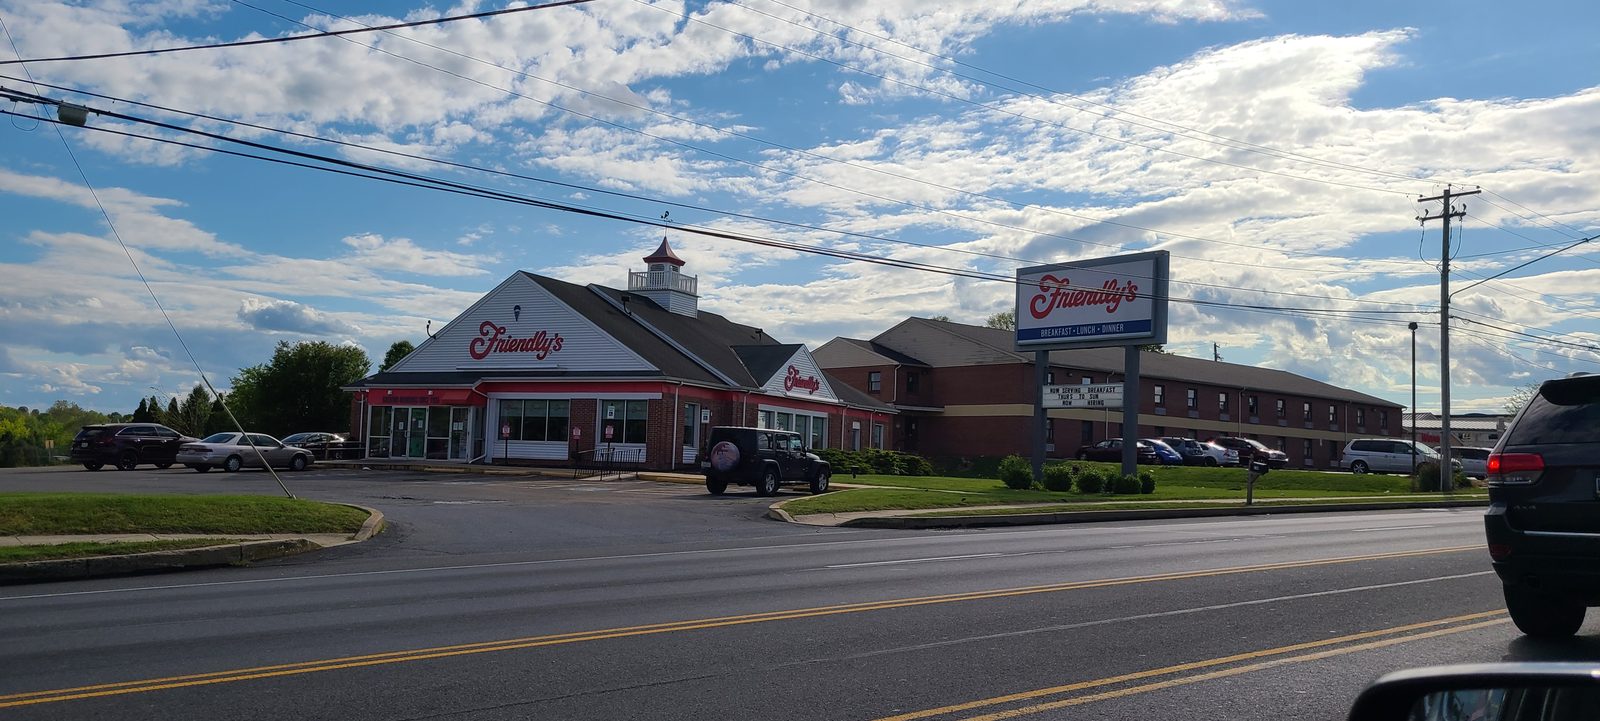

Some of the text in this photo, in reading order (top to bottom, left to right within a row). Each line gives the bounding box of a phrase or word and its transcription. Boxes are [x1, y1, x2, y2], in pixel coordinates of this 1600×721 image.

[1030, 274, 1138, 319] Friendly's
[469, 320, 564, 360] Friendly's
[1040, 323, 1124, 338] BREAKFAST LUNCH DINNER
[784, 364, 820, 395] Friendly's
